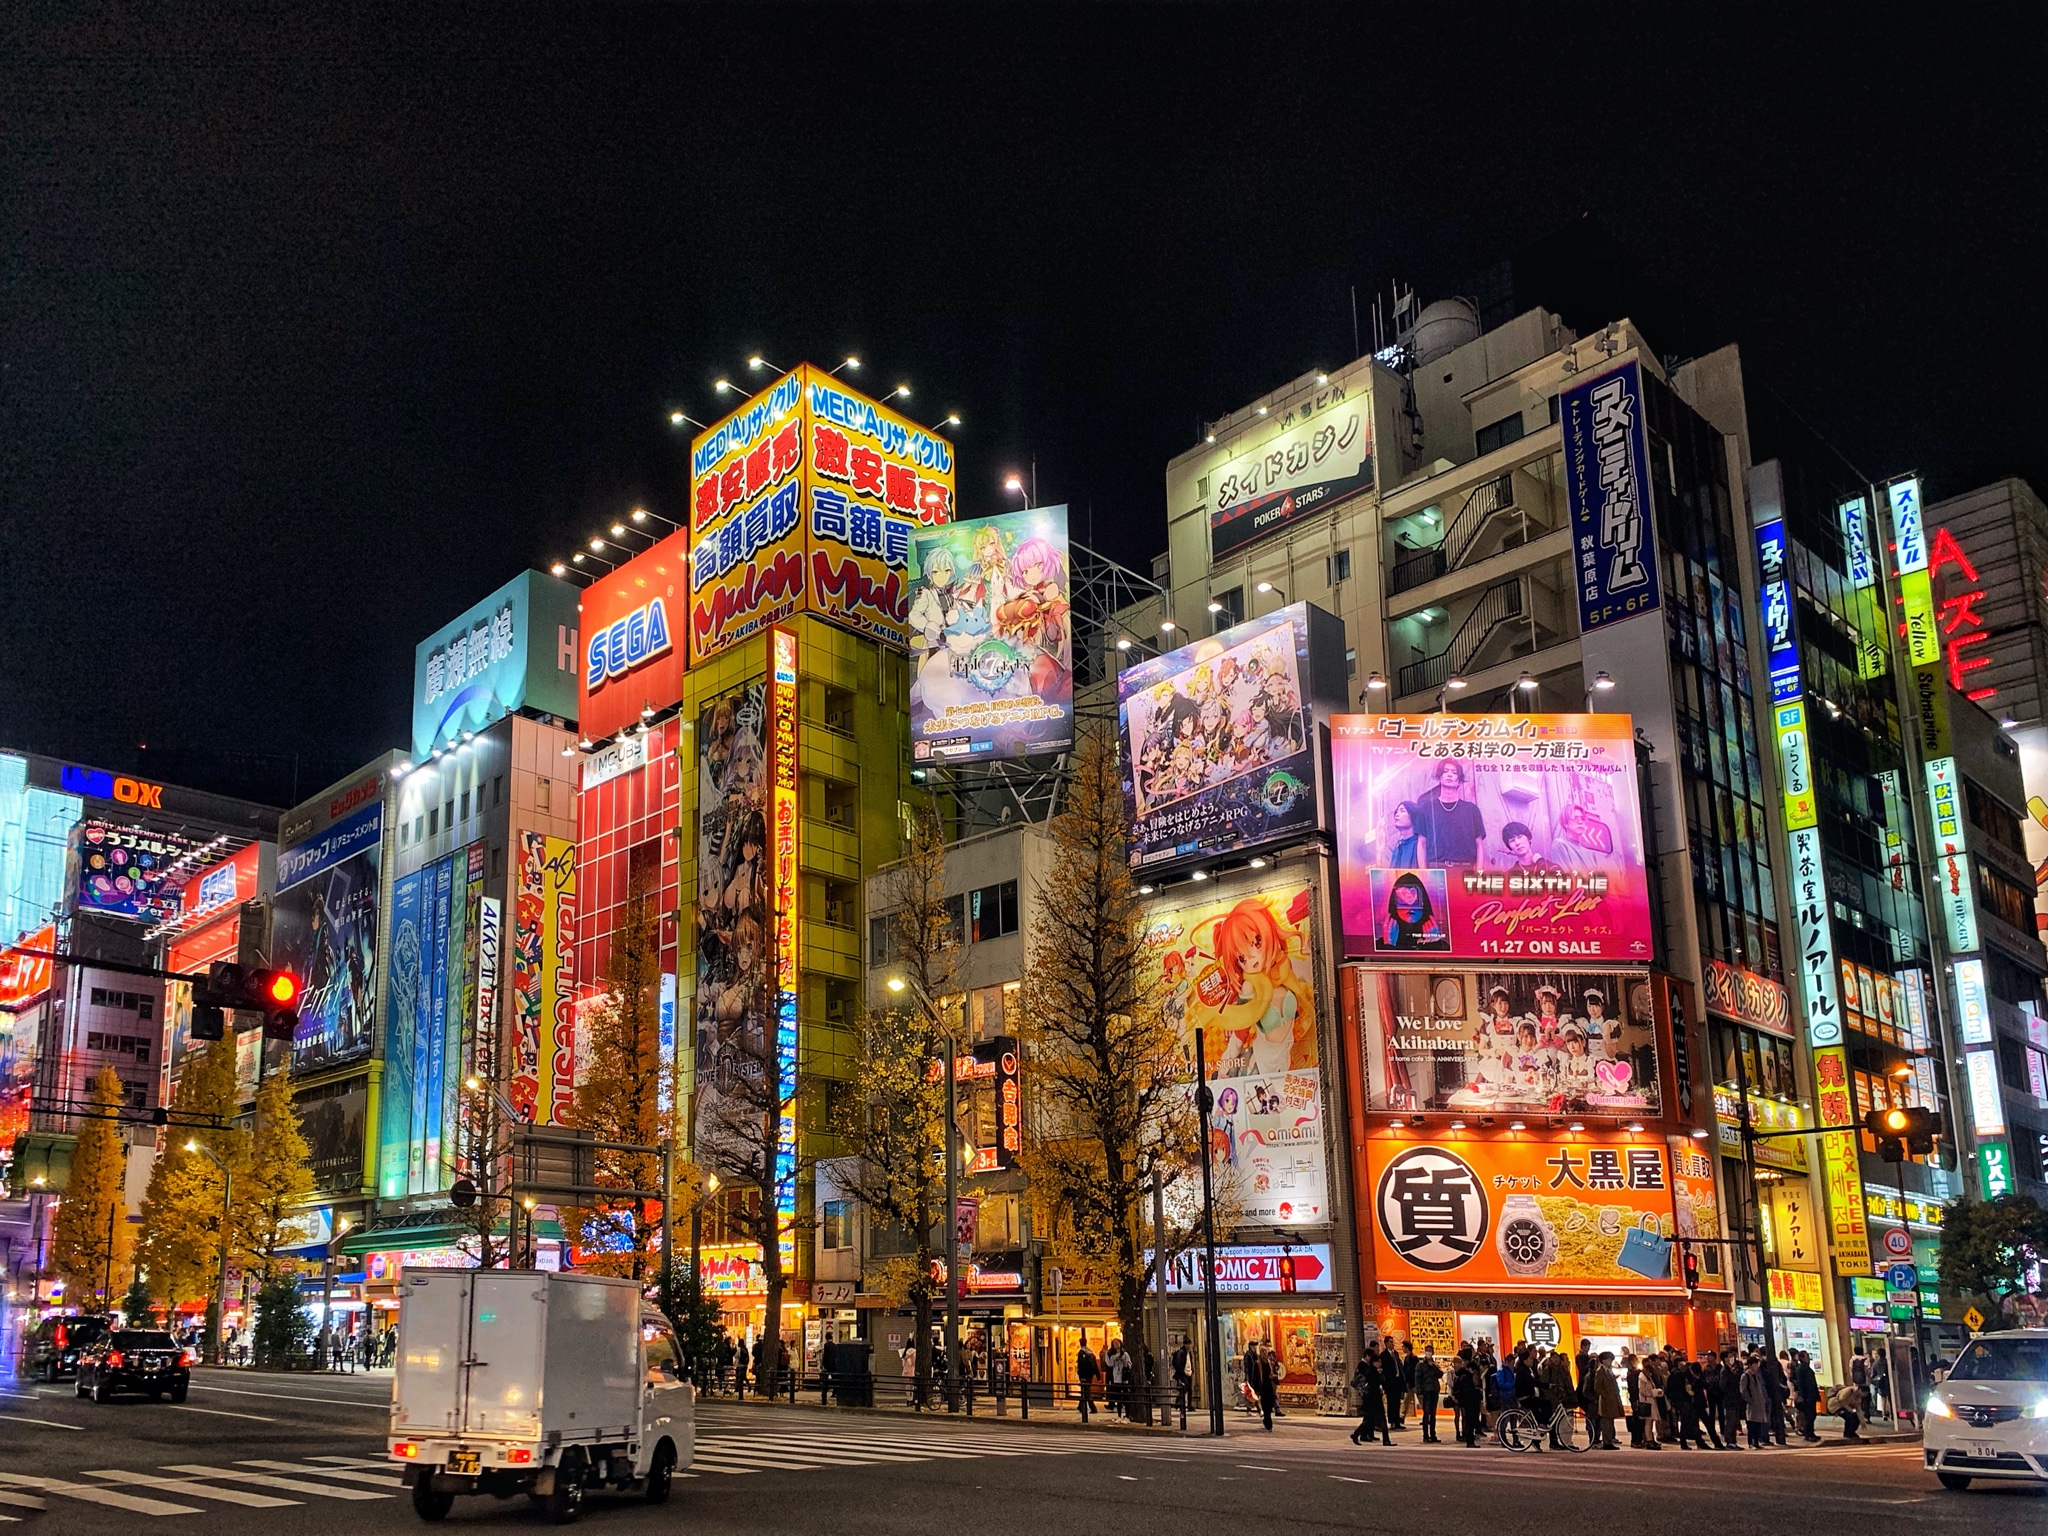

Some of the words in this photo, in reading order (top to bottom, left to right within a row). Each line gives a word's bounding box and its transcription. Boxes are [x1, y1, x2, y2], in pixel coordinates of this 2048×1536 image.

[695, 422, 800, 527] 激安販売
[814, 426, 949, 524] 激安販売
[1218, 414, 1360, 509] メイドカジノ
[1254, 507, 1281, 528] POKER
[1295, 486, 1324, 509] STARS
[693, 480, 799, 590] 高額買取
[813, 488, 908, 567] 高額買
[1897, 489, 1920, 565] スーパービル
[1580, 535, 1598, 602] 秋葉原店
[693, 553, 804, 656] Mulan
[587, 597, 672, 690] SEGA
[873, 623, 904, 645] AKIBA
[1910, 613, 1926, 659] Yellow
[954, 654, 984, 679] Epic
[777, 685, 794, 697] DVD
[777, 708, 794, 721] ゲーム
[1783, 712, 1798, 724] 3F
[1918, 672, 1939, 751] Submarine
[779, 720, 791, 731] CD
[1338, 727, 1351, 735] TV
[1353, 726, 1375, 735] アニメ
[1378, 719, 1537, 738] 「ゴールデンカムイ」
[777, 742, 794, 755] アニメ
[1384, 746, 1407, 754] アニメ
[1410, 741, 1590, 759] 「とある科学の一方通行」
[1786, 733, 1804, 792] りらくる
[1932, 761, 1948, 772] 5F
[1934, 784, 1959, 837] 秋葉館
[87, 819, 114, 831] ADULT
[116, 826, 165, 841] AMUSEMENT
[168, 835, 188, 845] PARK
[290, 838, 331, 875] ソフマップ
[1796, 833, 1817, 901] 喫茶室
[1464, 878, 1504, 891] THE
[1509, 878, 1571, 891] SIXTH
[1576, 878, 1608, 891] LIE
[1471, 895, 1556, 935] Perfect
[1550, 889, 1602, 922] Lies
[1480, 939, 1524, 953] 11.27
[1529, 941, 1554, 953] ON
[1558, 941, 1601, 954] SALE
[1801, 904, 1836, 1017] ルノアール
[1704, 963, 1790, 1029] メイドカジノ
[1962, 964, 1985, 1041] amiami
[1396, 1016, 1421, 1030] We
[1424, 1016, 1462, 1031] Love
[1387, 1036, 1475, 1050] Akihabara
[1216, 1057, 1246, 1071] STORE
[1284, 1074, 1317, 1089] あみあみ
[1816, 1054, 1851, 1126] 免税
[1625, 1096, 1648, 1106] cafe
[1002, 1079, 1018, 1152] 吉野家
[1267, 1126, 1316, 1141] amiami
[1719, 1126, 1739, 1142] りらくる
[1839, 1131, 1857, 1173] TAX
[1494, 1175, 1541, 1190] チケット
[1547, 1148, 1665, 1191] 大黒屋
[1245, 1208, 1257, 1217] and
[1259, 1207, 1276, 1216] more
[1390, 1165, 1479, 1257] 質
[1846, 1180, 1865, 1235] FREE
[1787, 1202, 1805, 1260] ルノアール
[1891, 1236, 1905, 1248] 40
[1264, 1257, 1282, 1280] ZI
[1838, 1251, 1868, 1259] AKIHABARA
[1894, 1271, 1905, 1288] P
[818, 1286, 850, 1301] ラーメン
[1436, 1298, 1451, 1308] 時計
[1528, 1319, 1558, 1348] 質
